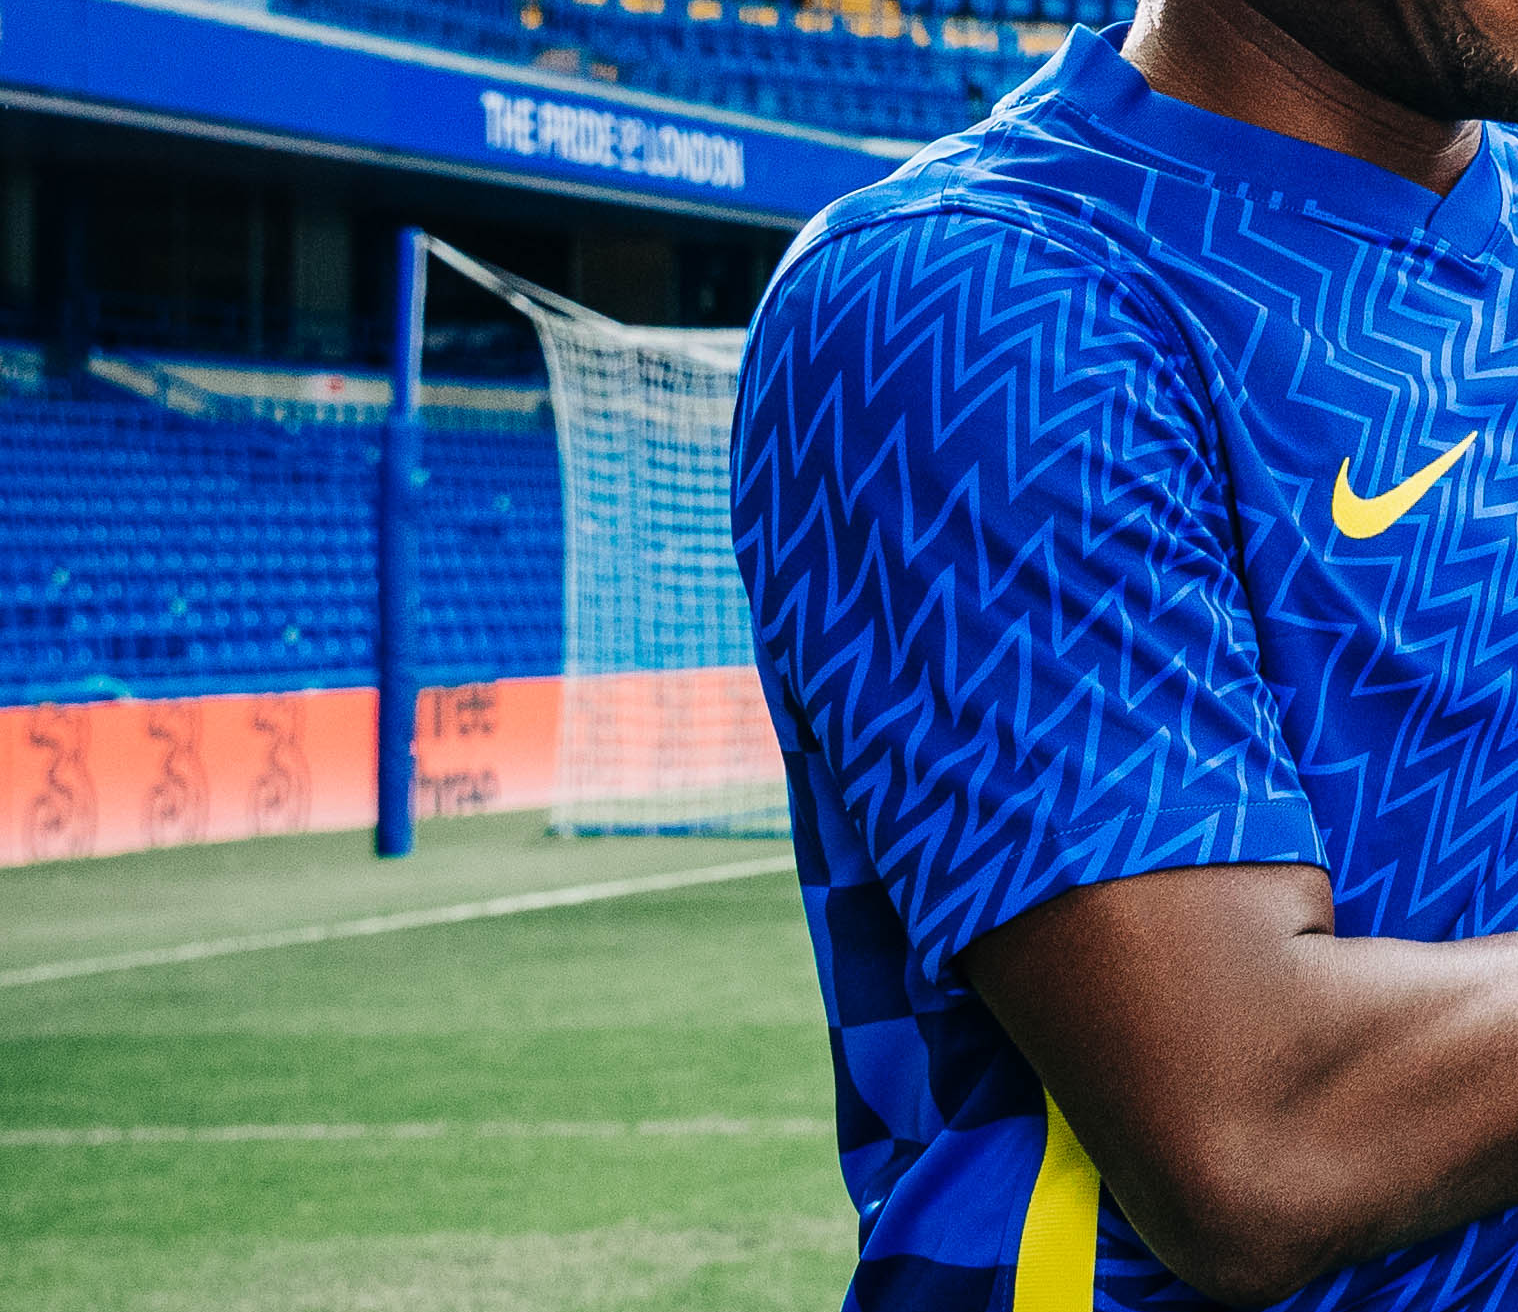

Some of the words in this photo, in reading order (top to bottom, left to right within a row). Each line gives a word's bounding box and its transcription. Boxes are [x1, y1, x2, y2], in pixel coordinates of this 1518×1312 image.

[480, 90, 537, 156] THE
[537, 101, 619, 167] PRIDE
[646, 121, 745, 190] LONDON
